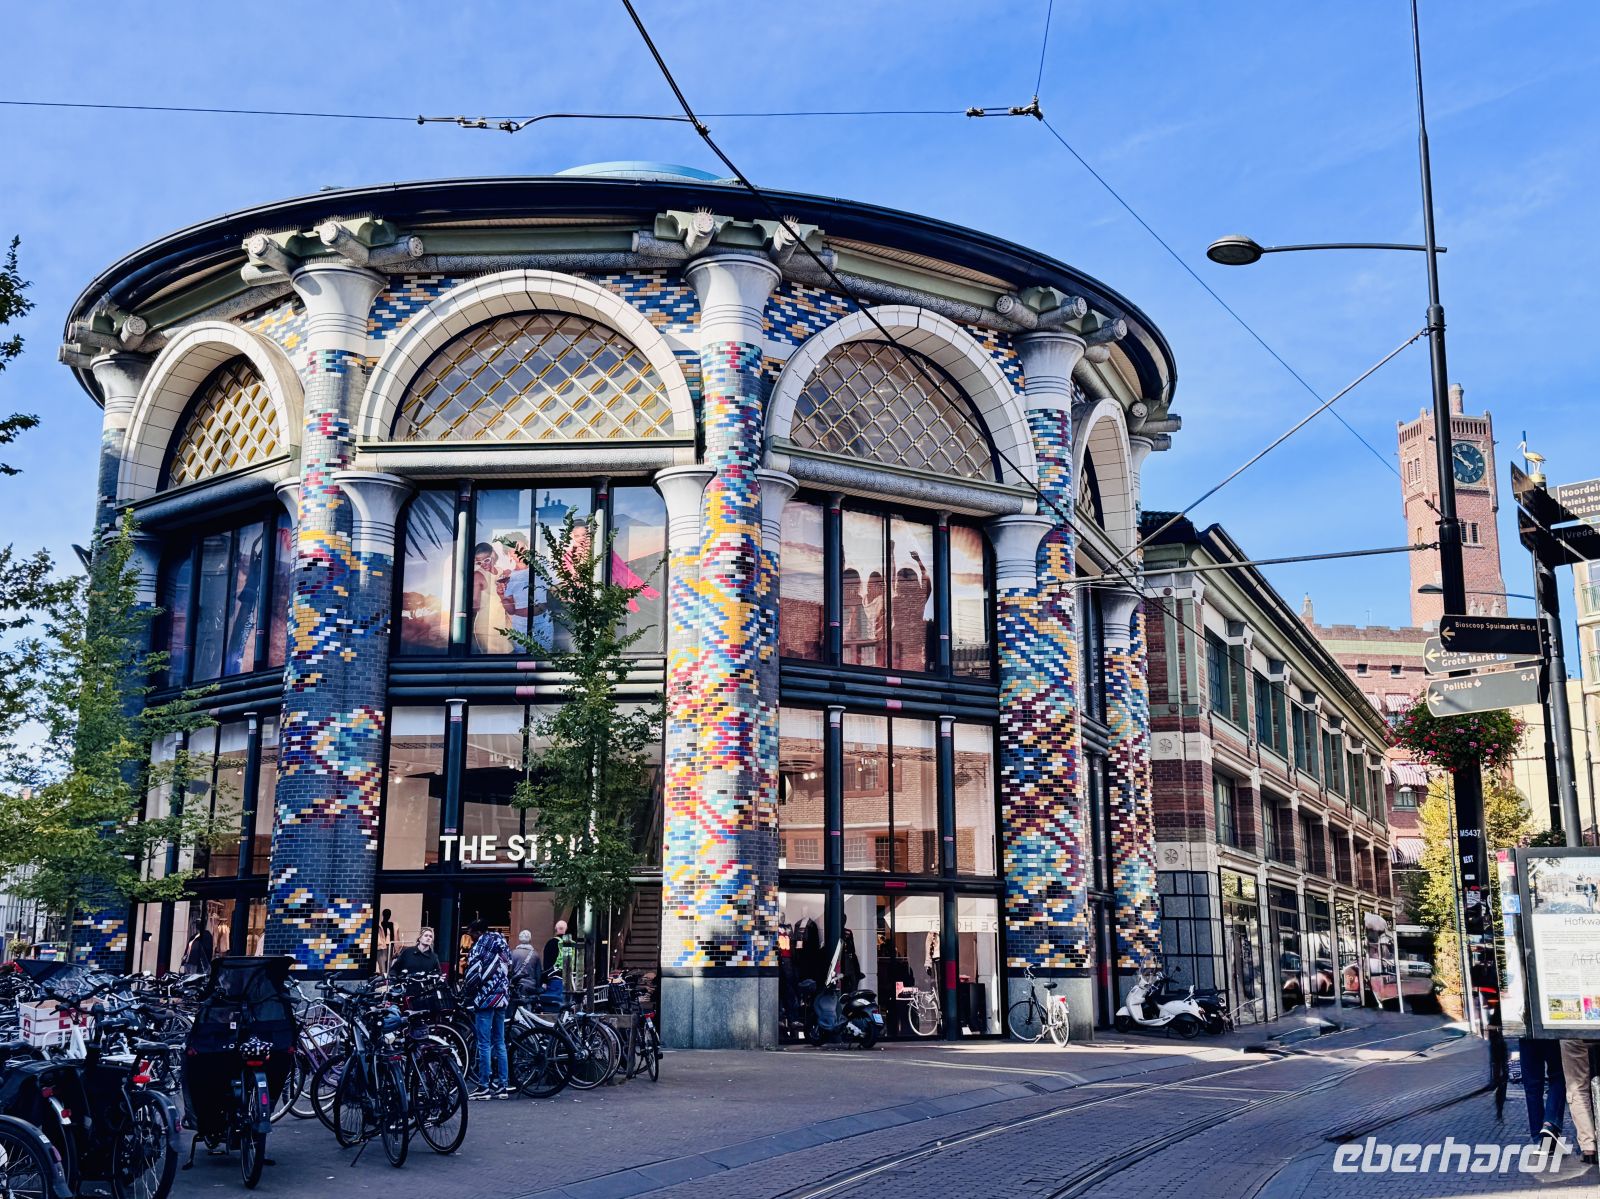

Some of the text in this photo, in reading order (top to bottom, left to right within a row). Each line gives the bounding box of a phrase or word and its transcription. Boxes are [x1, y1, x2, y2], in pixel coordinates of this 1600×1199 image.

[1562, 496, 1586, 507] Paleis
[1455, 621, 1485, 630] Bioscoop
[1486, 622, 1519, 631] Spuimarkt
[1441, 655, 1495, 667] Grote Markt
[1443, 681, 1473, 692] Politie
[439, 835, 498, 862] THE
